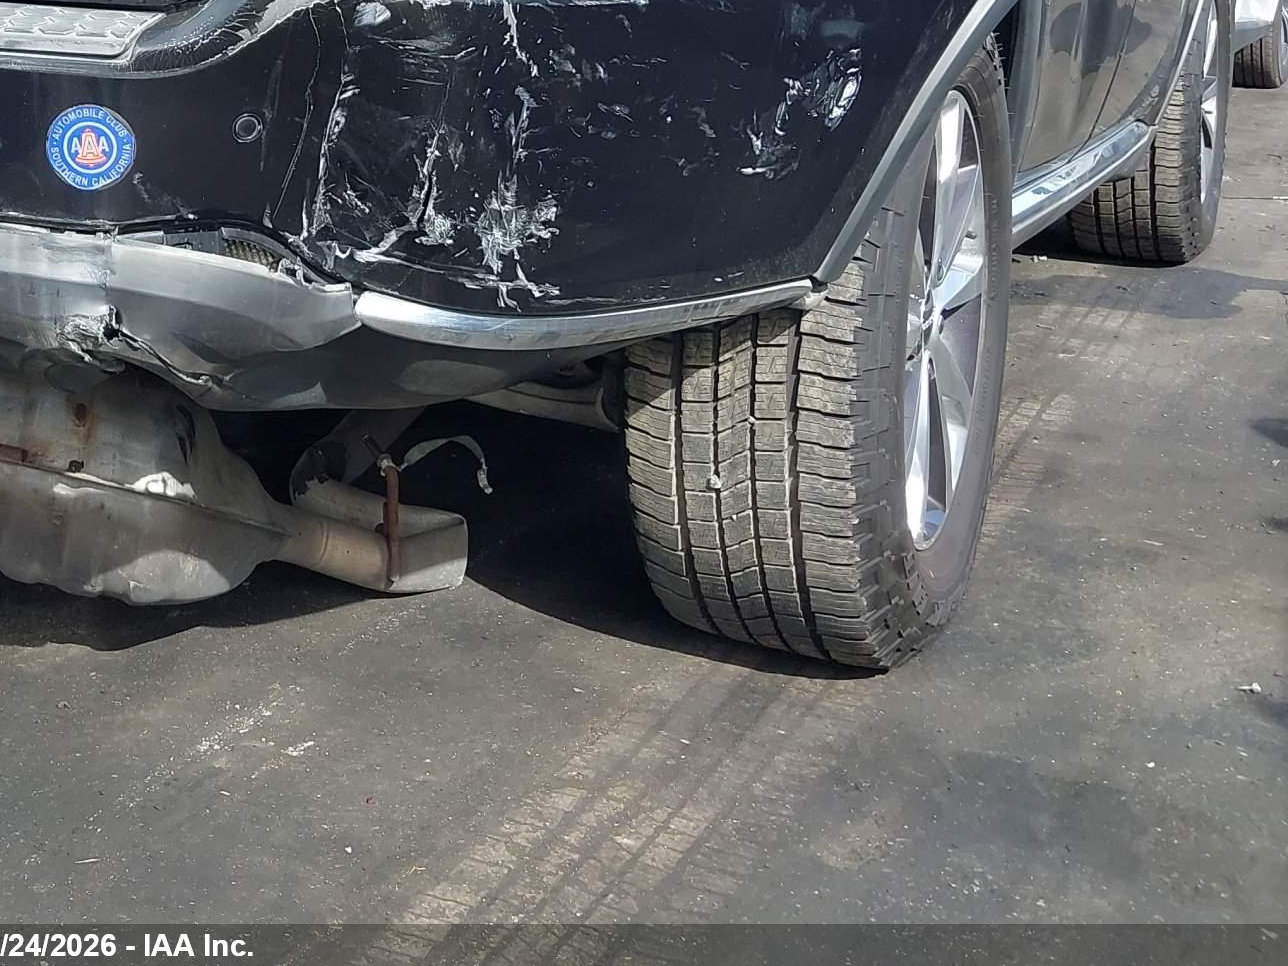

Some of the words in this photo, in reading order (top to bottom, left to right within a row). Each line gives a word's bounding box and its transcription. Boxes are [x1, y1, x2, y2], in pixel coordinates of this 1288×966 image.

[53, 108, 105, 141] AUTOMOBILE
[105, 114, 128, 139] CLUB
[71, 134, 110, 158] AAA
[50, 146, 89, 187] SOUTHERN
[92, 143, 132, 187] CALIFORNIA
